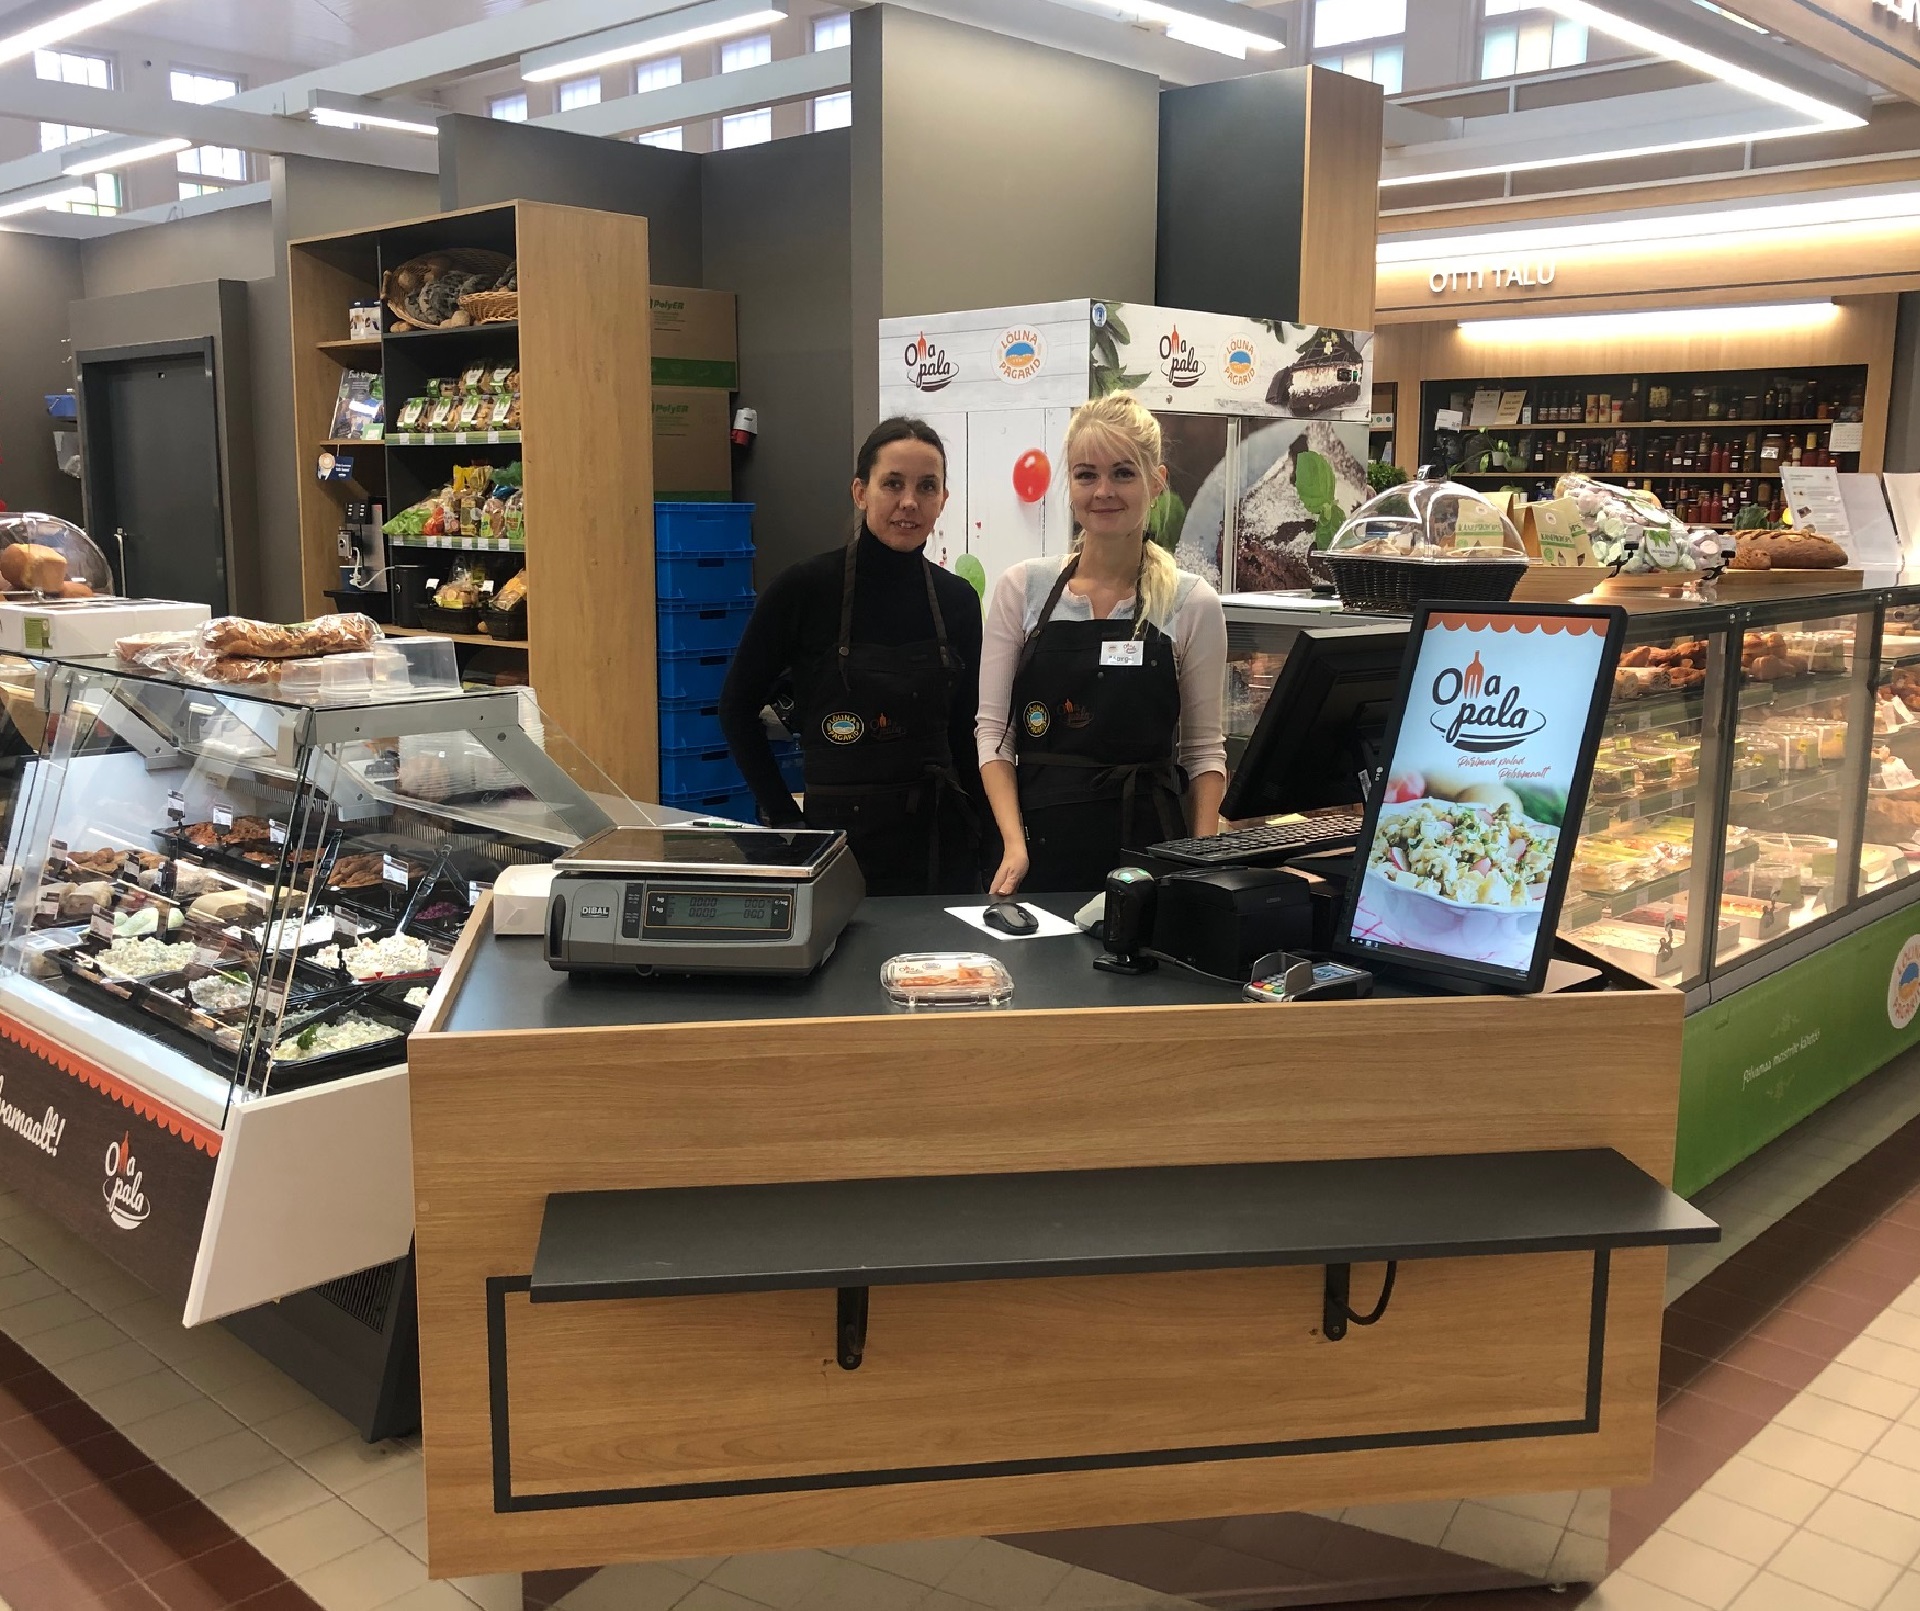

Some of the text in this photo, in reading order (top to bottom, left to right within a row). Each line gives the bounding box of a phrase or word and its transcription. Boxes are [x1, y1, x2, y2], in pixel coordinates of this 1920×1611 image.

[1429, 260, 1556, 293] OTTI TALU
[916, 350, 950, 388] pala
[1000, 358, 1041, 379] PAGARID
[1169, 347, 1198, 383] pala
[1225, 366, 1255, 386] PAGARID
[1445, 686, 1529, 743] pala
[828, 730, 859, 741] PAGARID
[582, 906, 609, 915] DIBAL
[108, 1171, 144, 1213] pala
